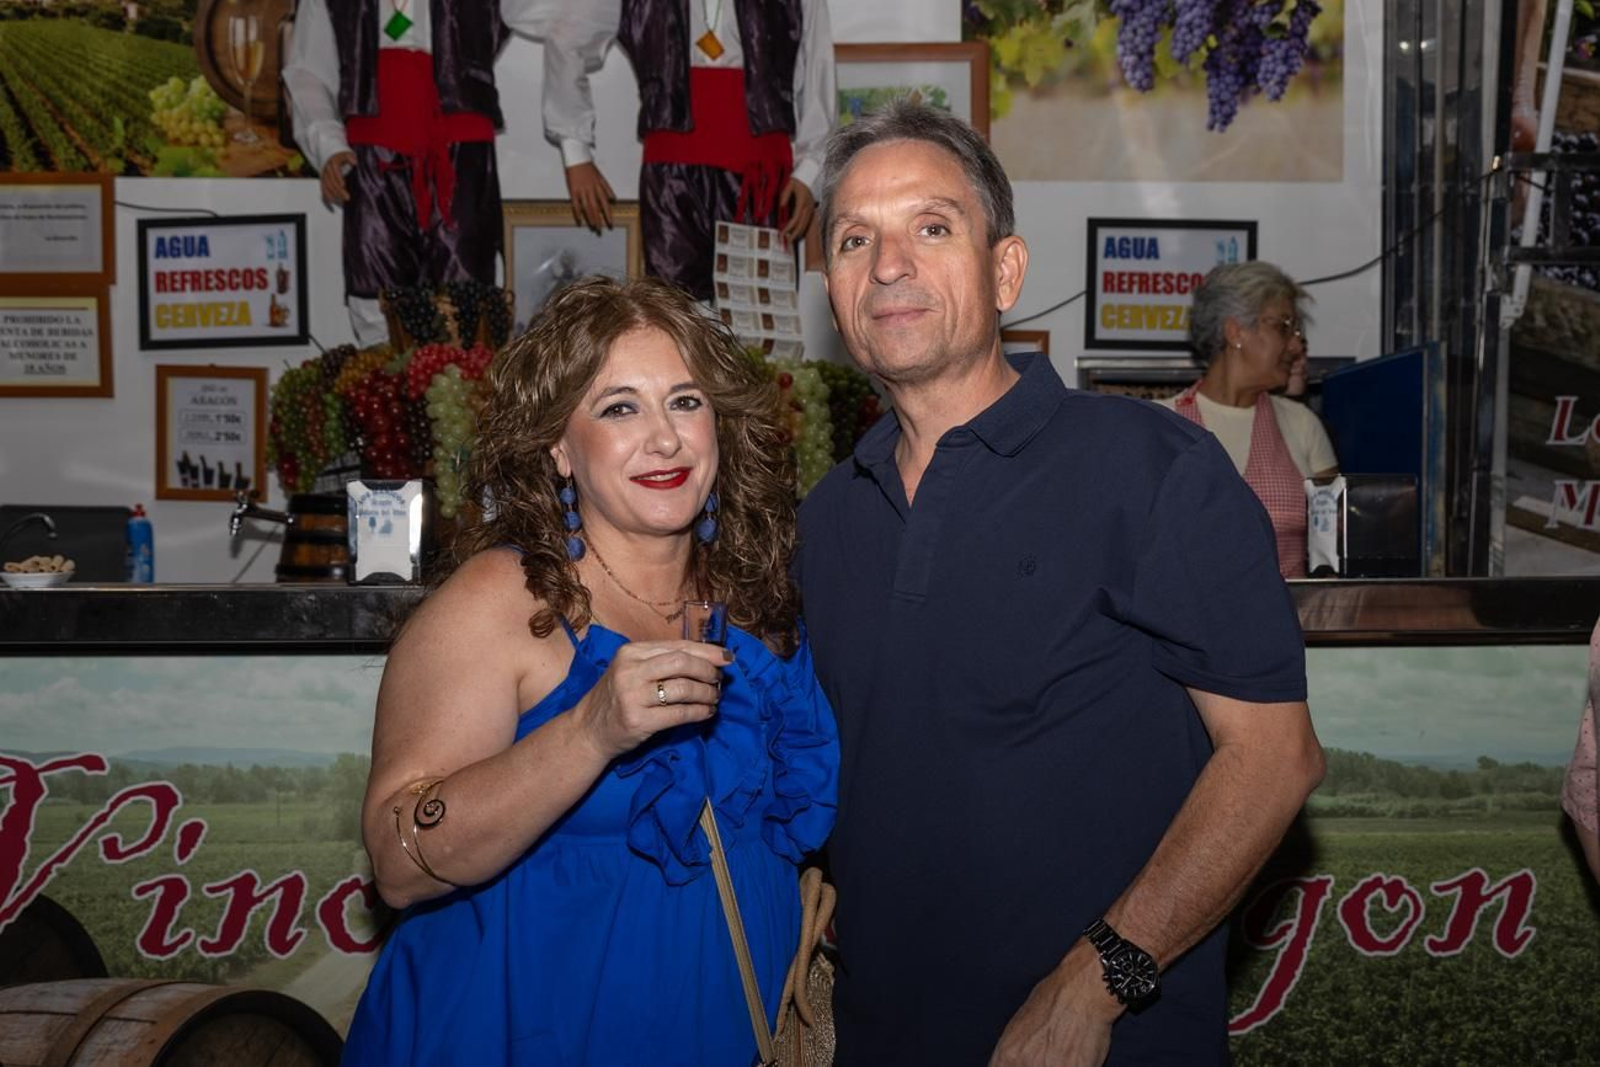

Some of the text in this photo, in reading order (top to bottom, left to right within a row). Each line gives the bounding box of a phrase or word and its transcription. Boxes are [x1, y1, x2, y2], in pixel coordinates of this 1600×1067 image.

[155, 235, 210, 259] AGUA
[1103, 236, 1160, 260] AGUA
[155, 267, 269, 294] REFRESCOS
[1102, 271, 1210, 295] REFRESCO
[155, 300, 252, 329] CERVEZA
